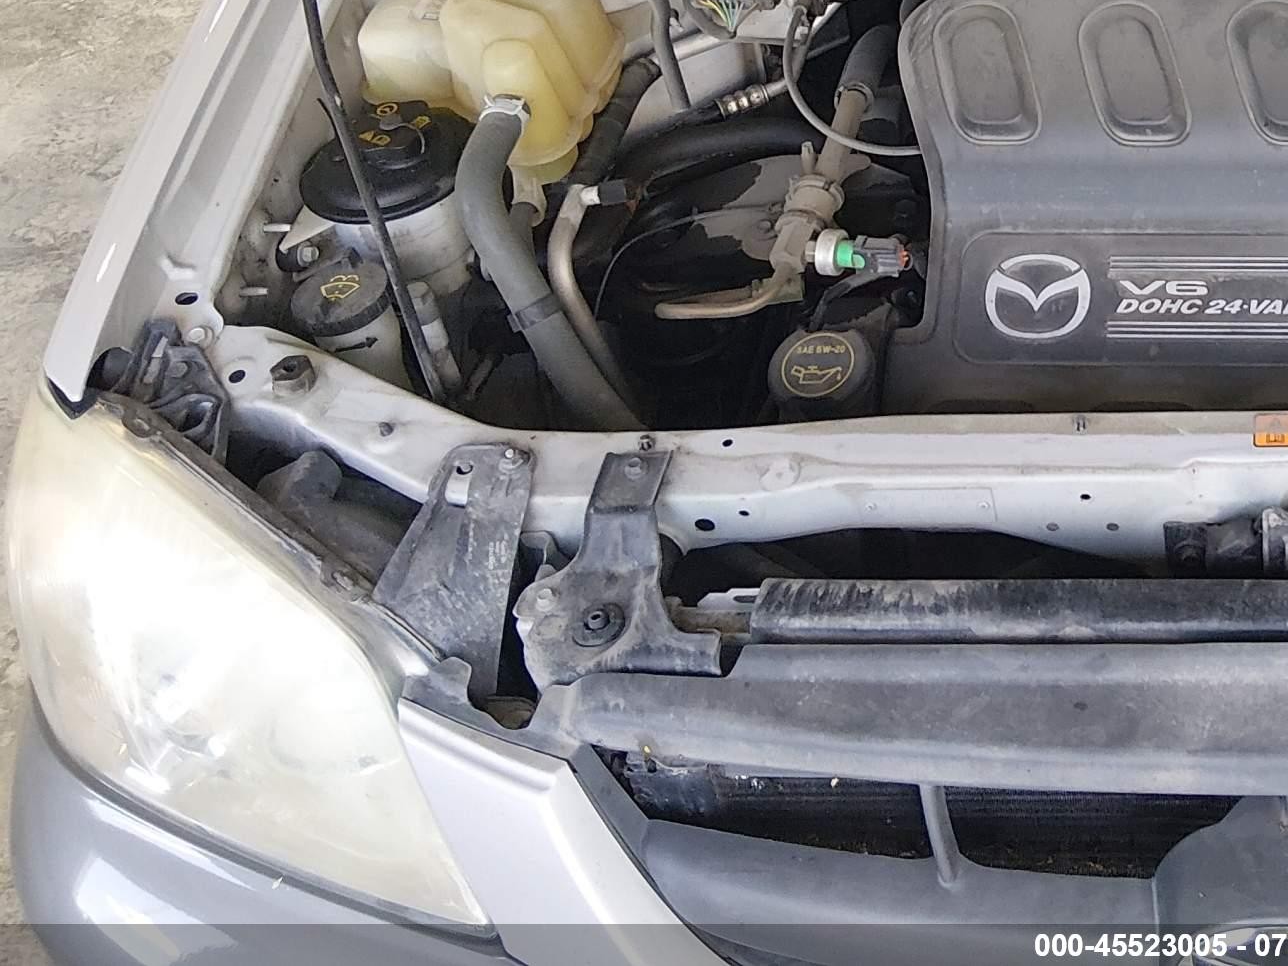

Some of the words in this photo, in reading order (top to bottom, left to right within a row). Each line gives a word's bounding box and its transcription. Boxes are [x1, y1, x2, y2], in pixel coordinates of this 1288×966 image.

[1119, 280, 1209, 296] V6
[1116, 299, 1203, 314] DOHC
[797, 345, 814, 354] SAE
